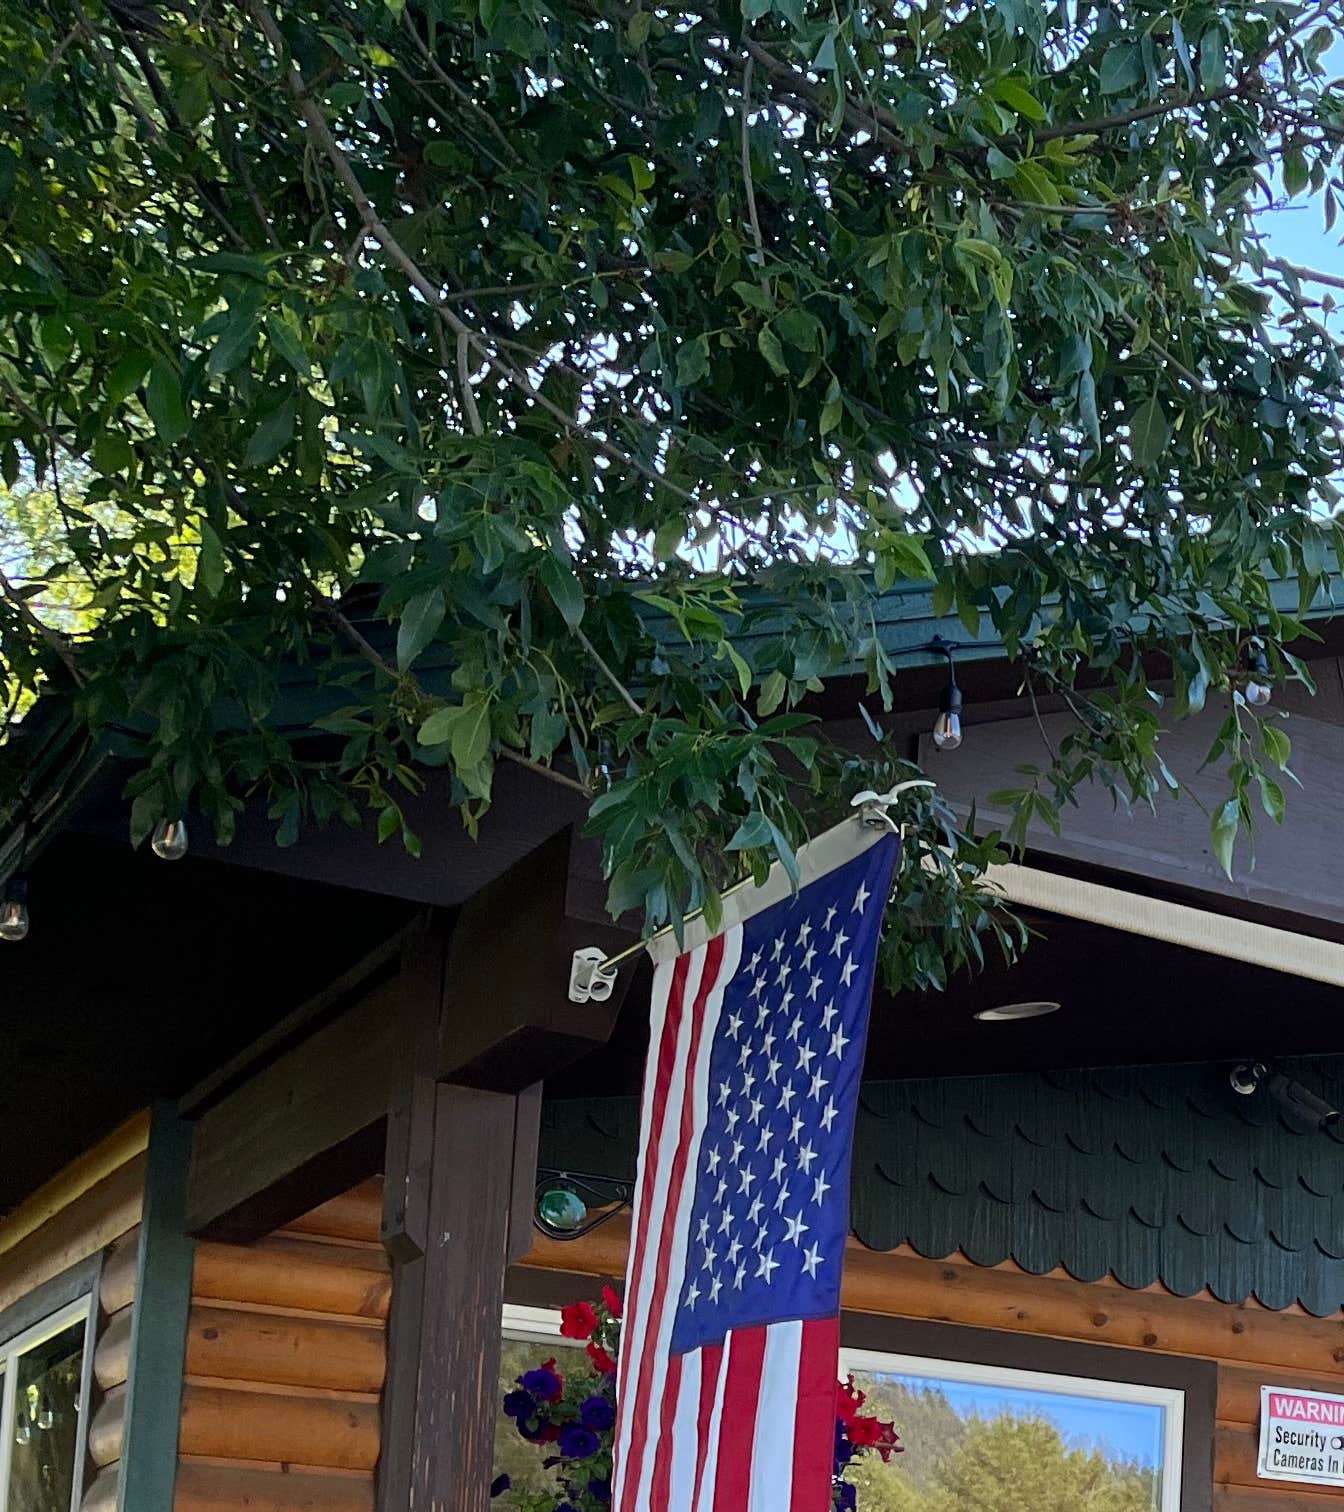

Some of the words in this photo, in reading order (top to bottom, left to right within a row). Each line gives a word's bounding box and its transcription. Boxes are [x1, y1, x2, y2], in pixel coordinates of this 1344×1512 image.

[1275, 1426, 1327, 1452] Security
[1273, 1449, 1324, 1472] Cameras
[1328, 1455, 1339, 1473] In
